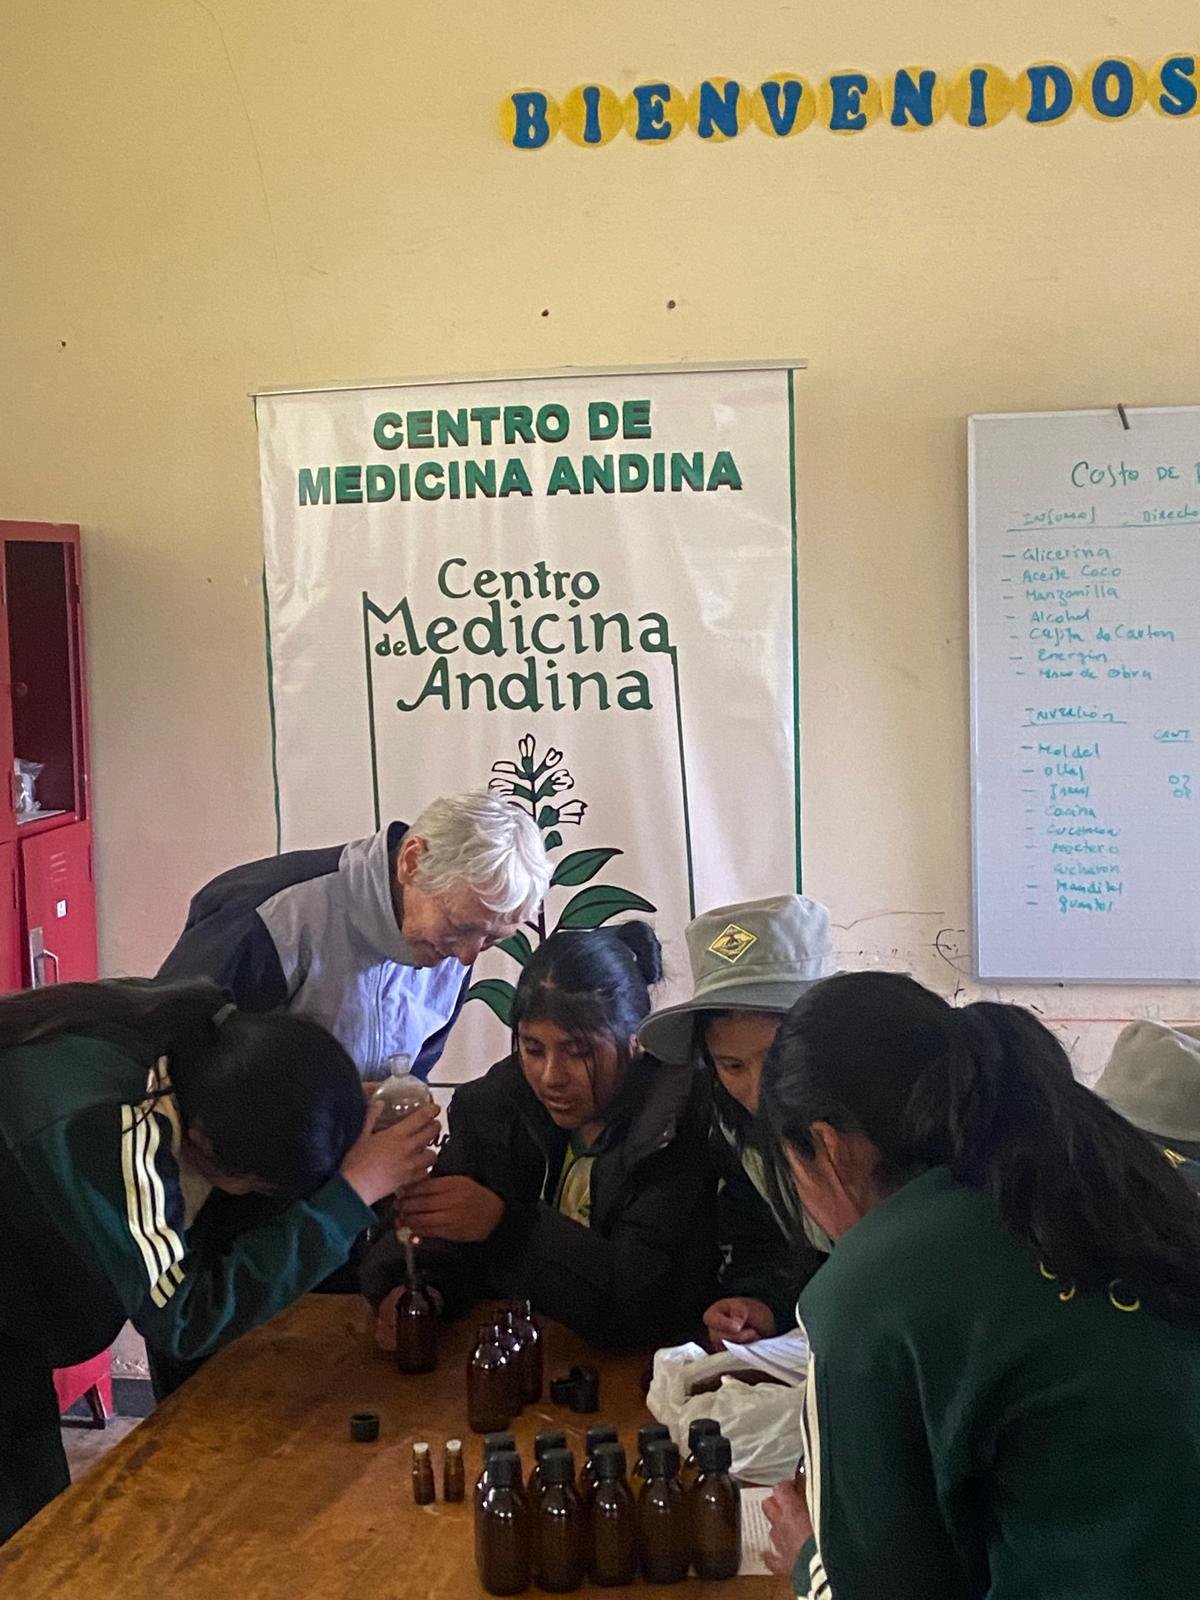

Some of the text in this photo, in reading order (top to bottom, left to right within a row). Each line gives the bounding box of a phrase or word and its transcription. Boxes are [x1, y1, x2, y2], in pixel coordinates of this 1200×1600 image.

[511, 56, 1200, 150] BIENVENIDOS
[373, 400, 652, 450] CENTRO DE
[299, 450, 743, 506] MEDICINA ANDINA
[437, 557, 600, 601] Centro
[1023, 545, 1111, 562] Glicerina
[363, 590, 678, 659] de Medicina
[396, 656, 654, 713] Andina
